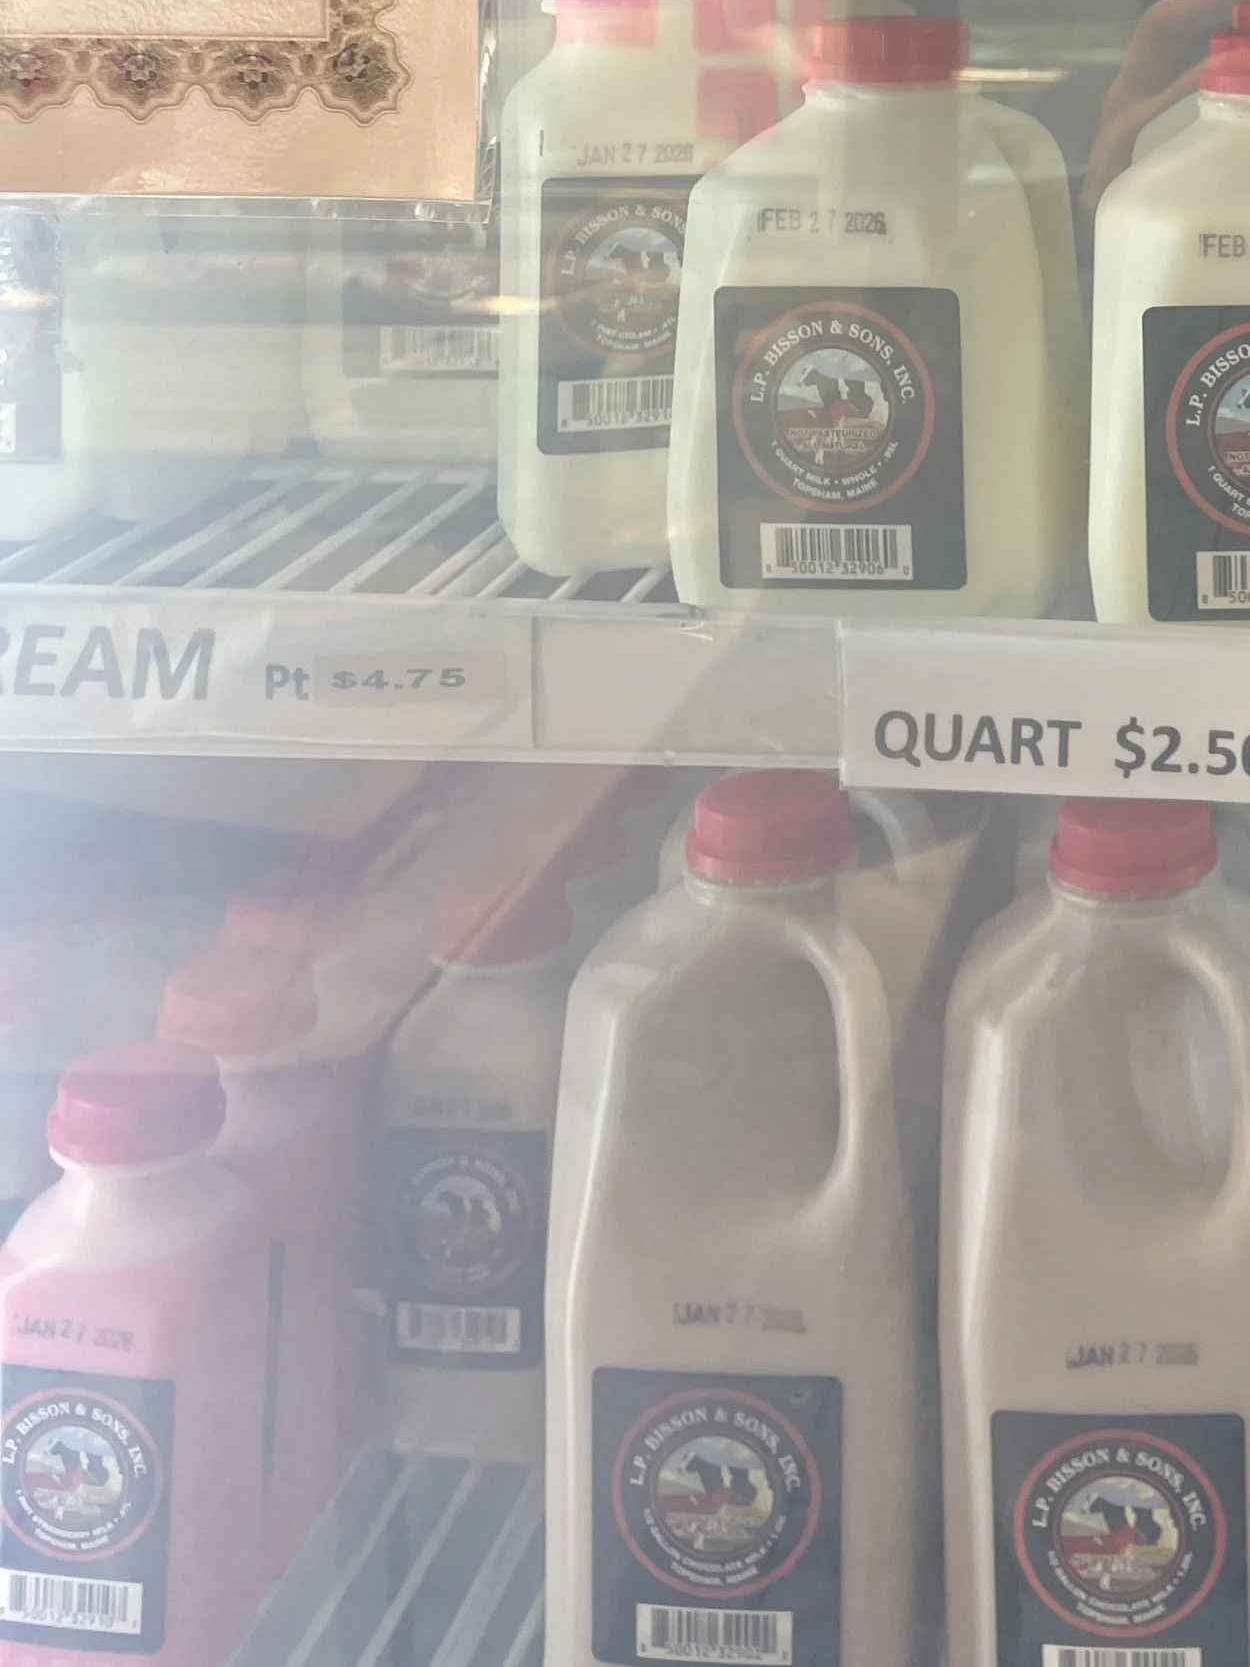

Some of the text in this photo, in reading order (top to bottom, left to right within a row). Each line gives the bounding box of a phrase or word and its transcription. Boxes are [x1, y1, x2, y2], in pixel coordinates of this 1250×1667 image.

[576, 144, 616, 167] JAN
[575, 204, 631, 246] BISSON
[634, 203, 648, 218] &
[757, 208, 802, 232] FEB
[844, 211, 887, 235] 2026
[1199, 233, 1246, 259] FEB
[750, 318, 916, 404] L.P. BISSON & SONS, INC.
[1185, 391, 1208, 427] L.P.
[775, 448, 807, 478] QUART
[804, 471, 832, 487] MILK
[841, 464, 878, 487] WHOLE
[1228, 451, 1250, 462] NOT
[792, 477, 879, 502] TOPSHAM, MAINE
[1212, 472, 1247, 503] QUART
[0, 623, 467, 702] EAM Pt $4.75
[874, 710, 1083, 768] QUART
[15, 1401, 71, 1435] BISSON
[75, 1403, 88, 1417] &
[1045, 1446, 1110, 1493] BISSON
[1115, 1446, 1130, 1464] &
